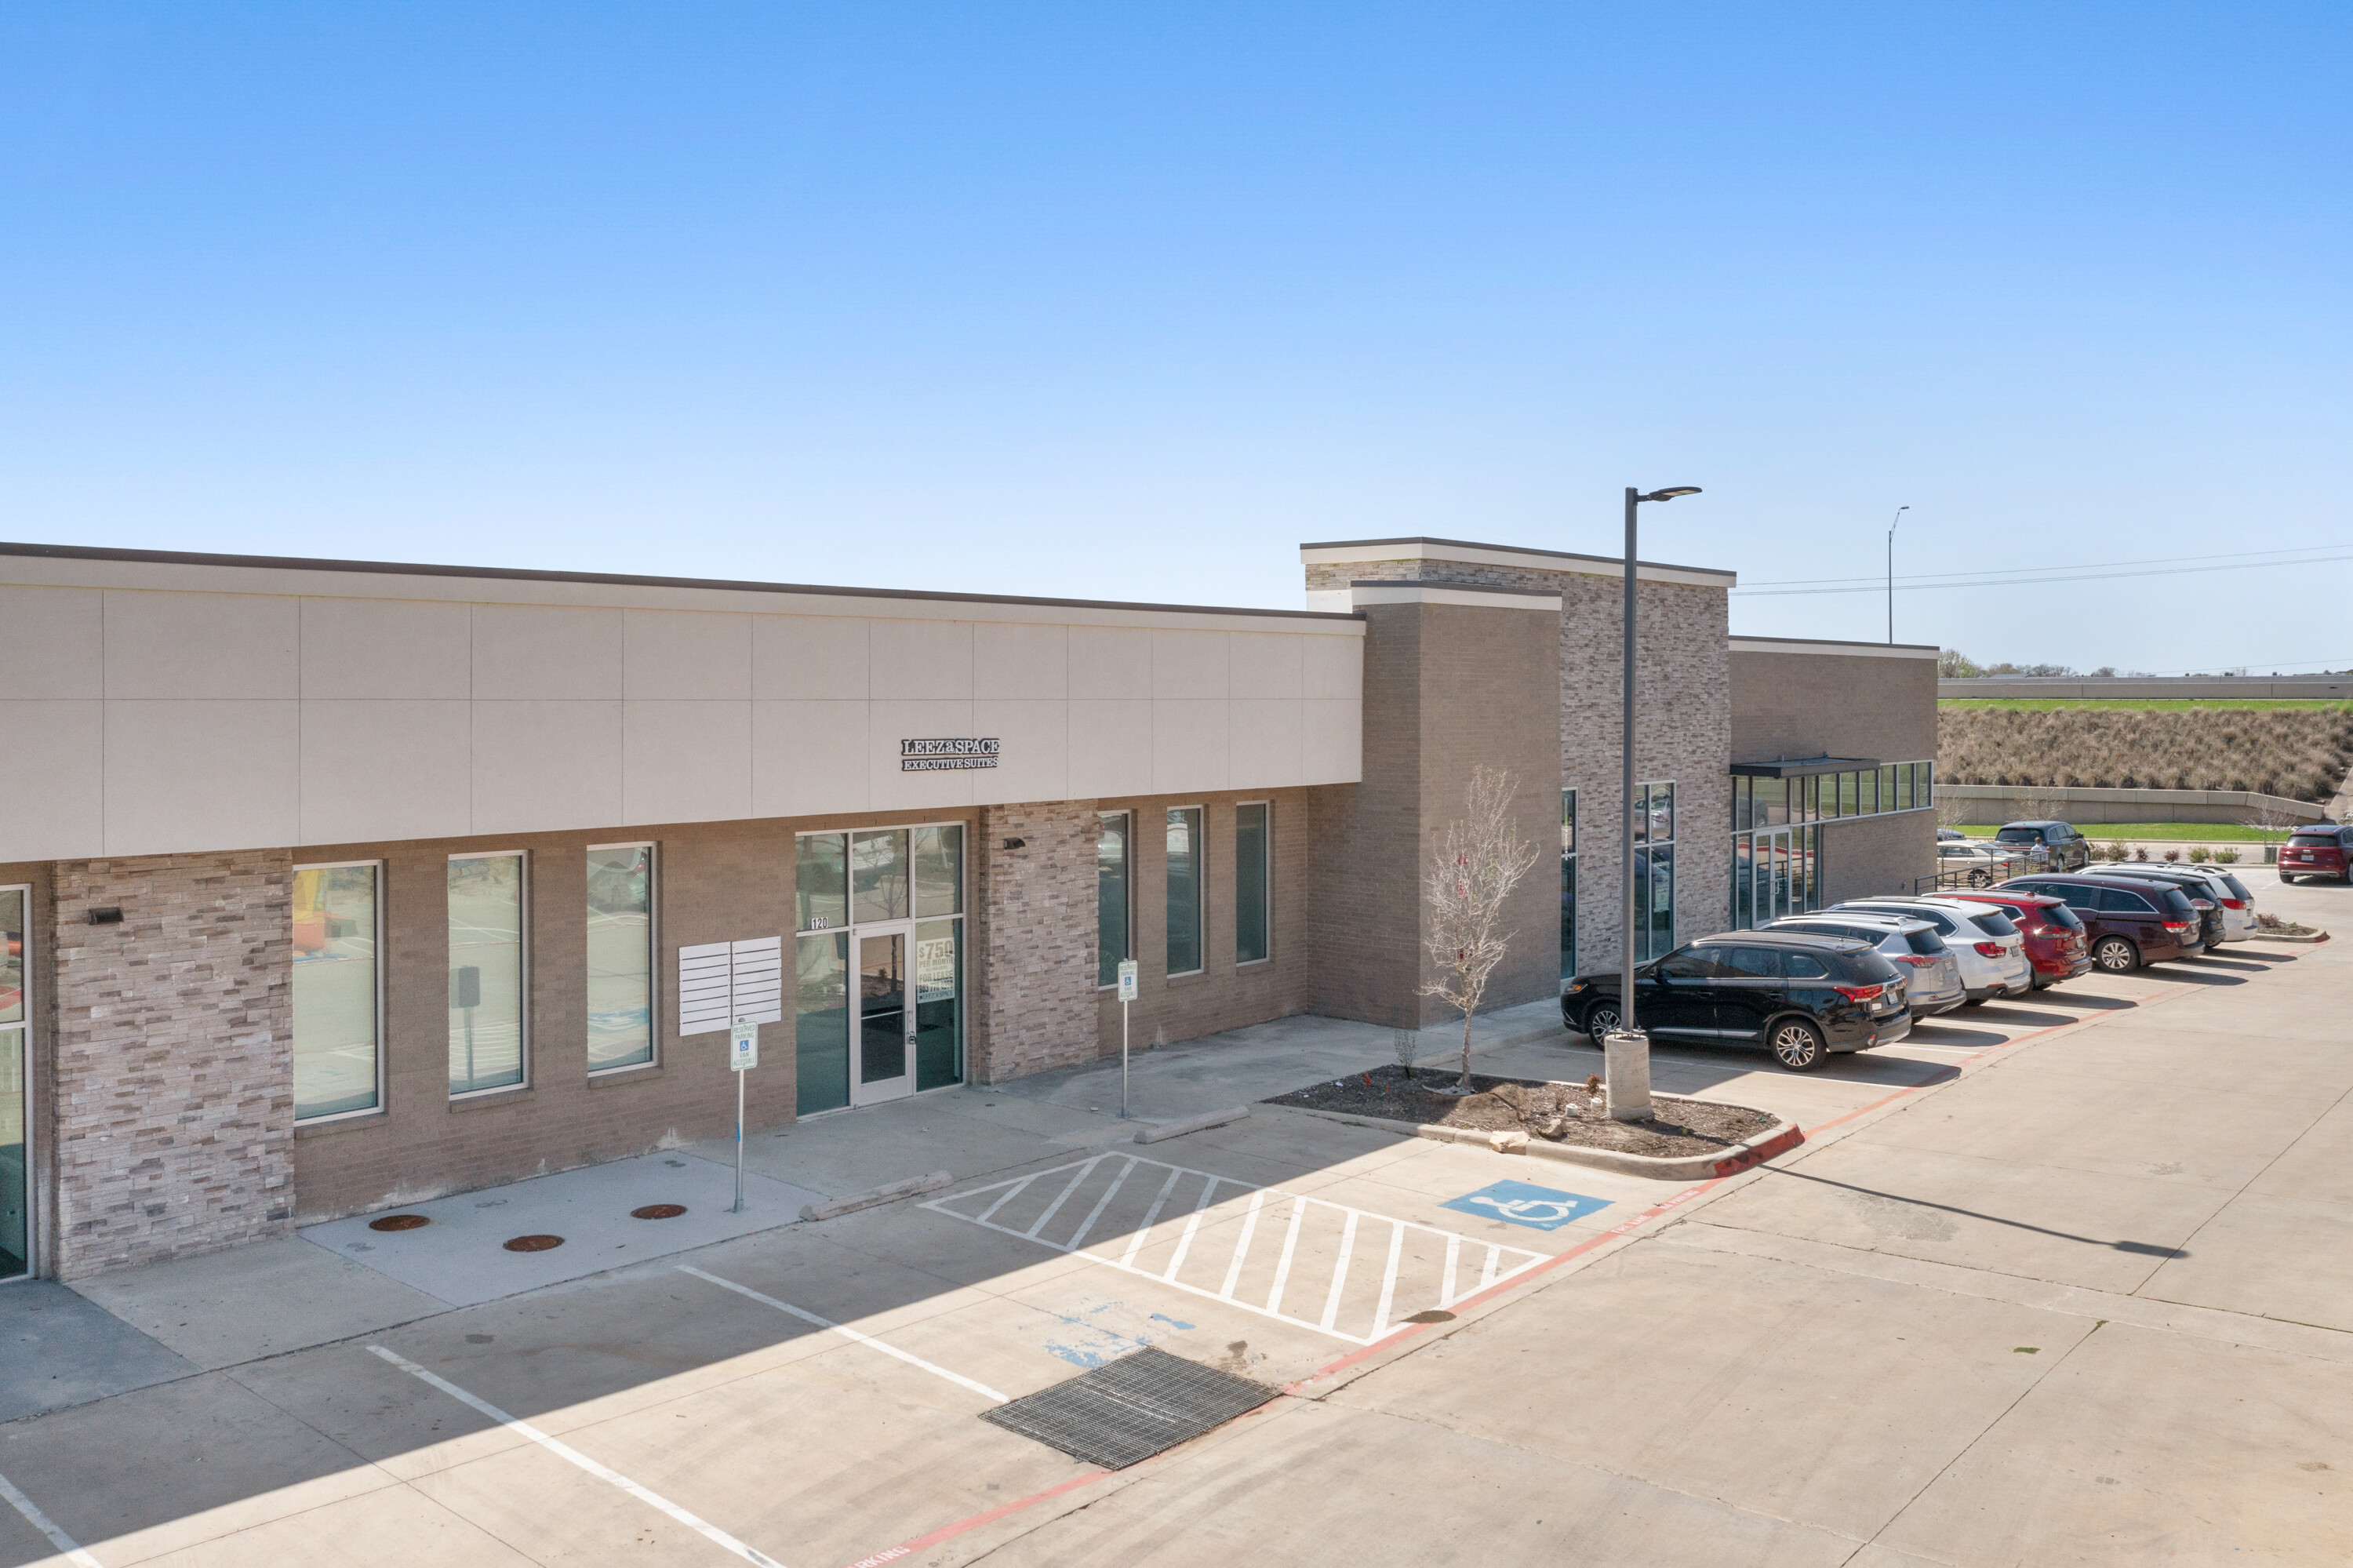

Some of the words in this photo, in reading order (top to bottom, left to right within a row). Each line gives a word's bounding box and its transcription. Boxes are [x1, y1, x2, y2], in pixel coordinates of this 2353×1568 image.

[902, 757, 963, 771] EXECUTIVE
[964, 756, 999, 768] SUITES
[813, 917, 827, 929] 120
[919, 940, 953, 959] $750
[933, 958, 953, 966] MONTH
[919, 973, 932, 983] FOR
[933, 970, 953, 981] LEASE
[733, 1024, 755, 1034] RESERVED
[733, 1057, 755, 1066] ACCESSIBLE
